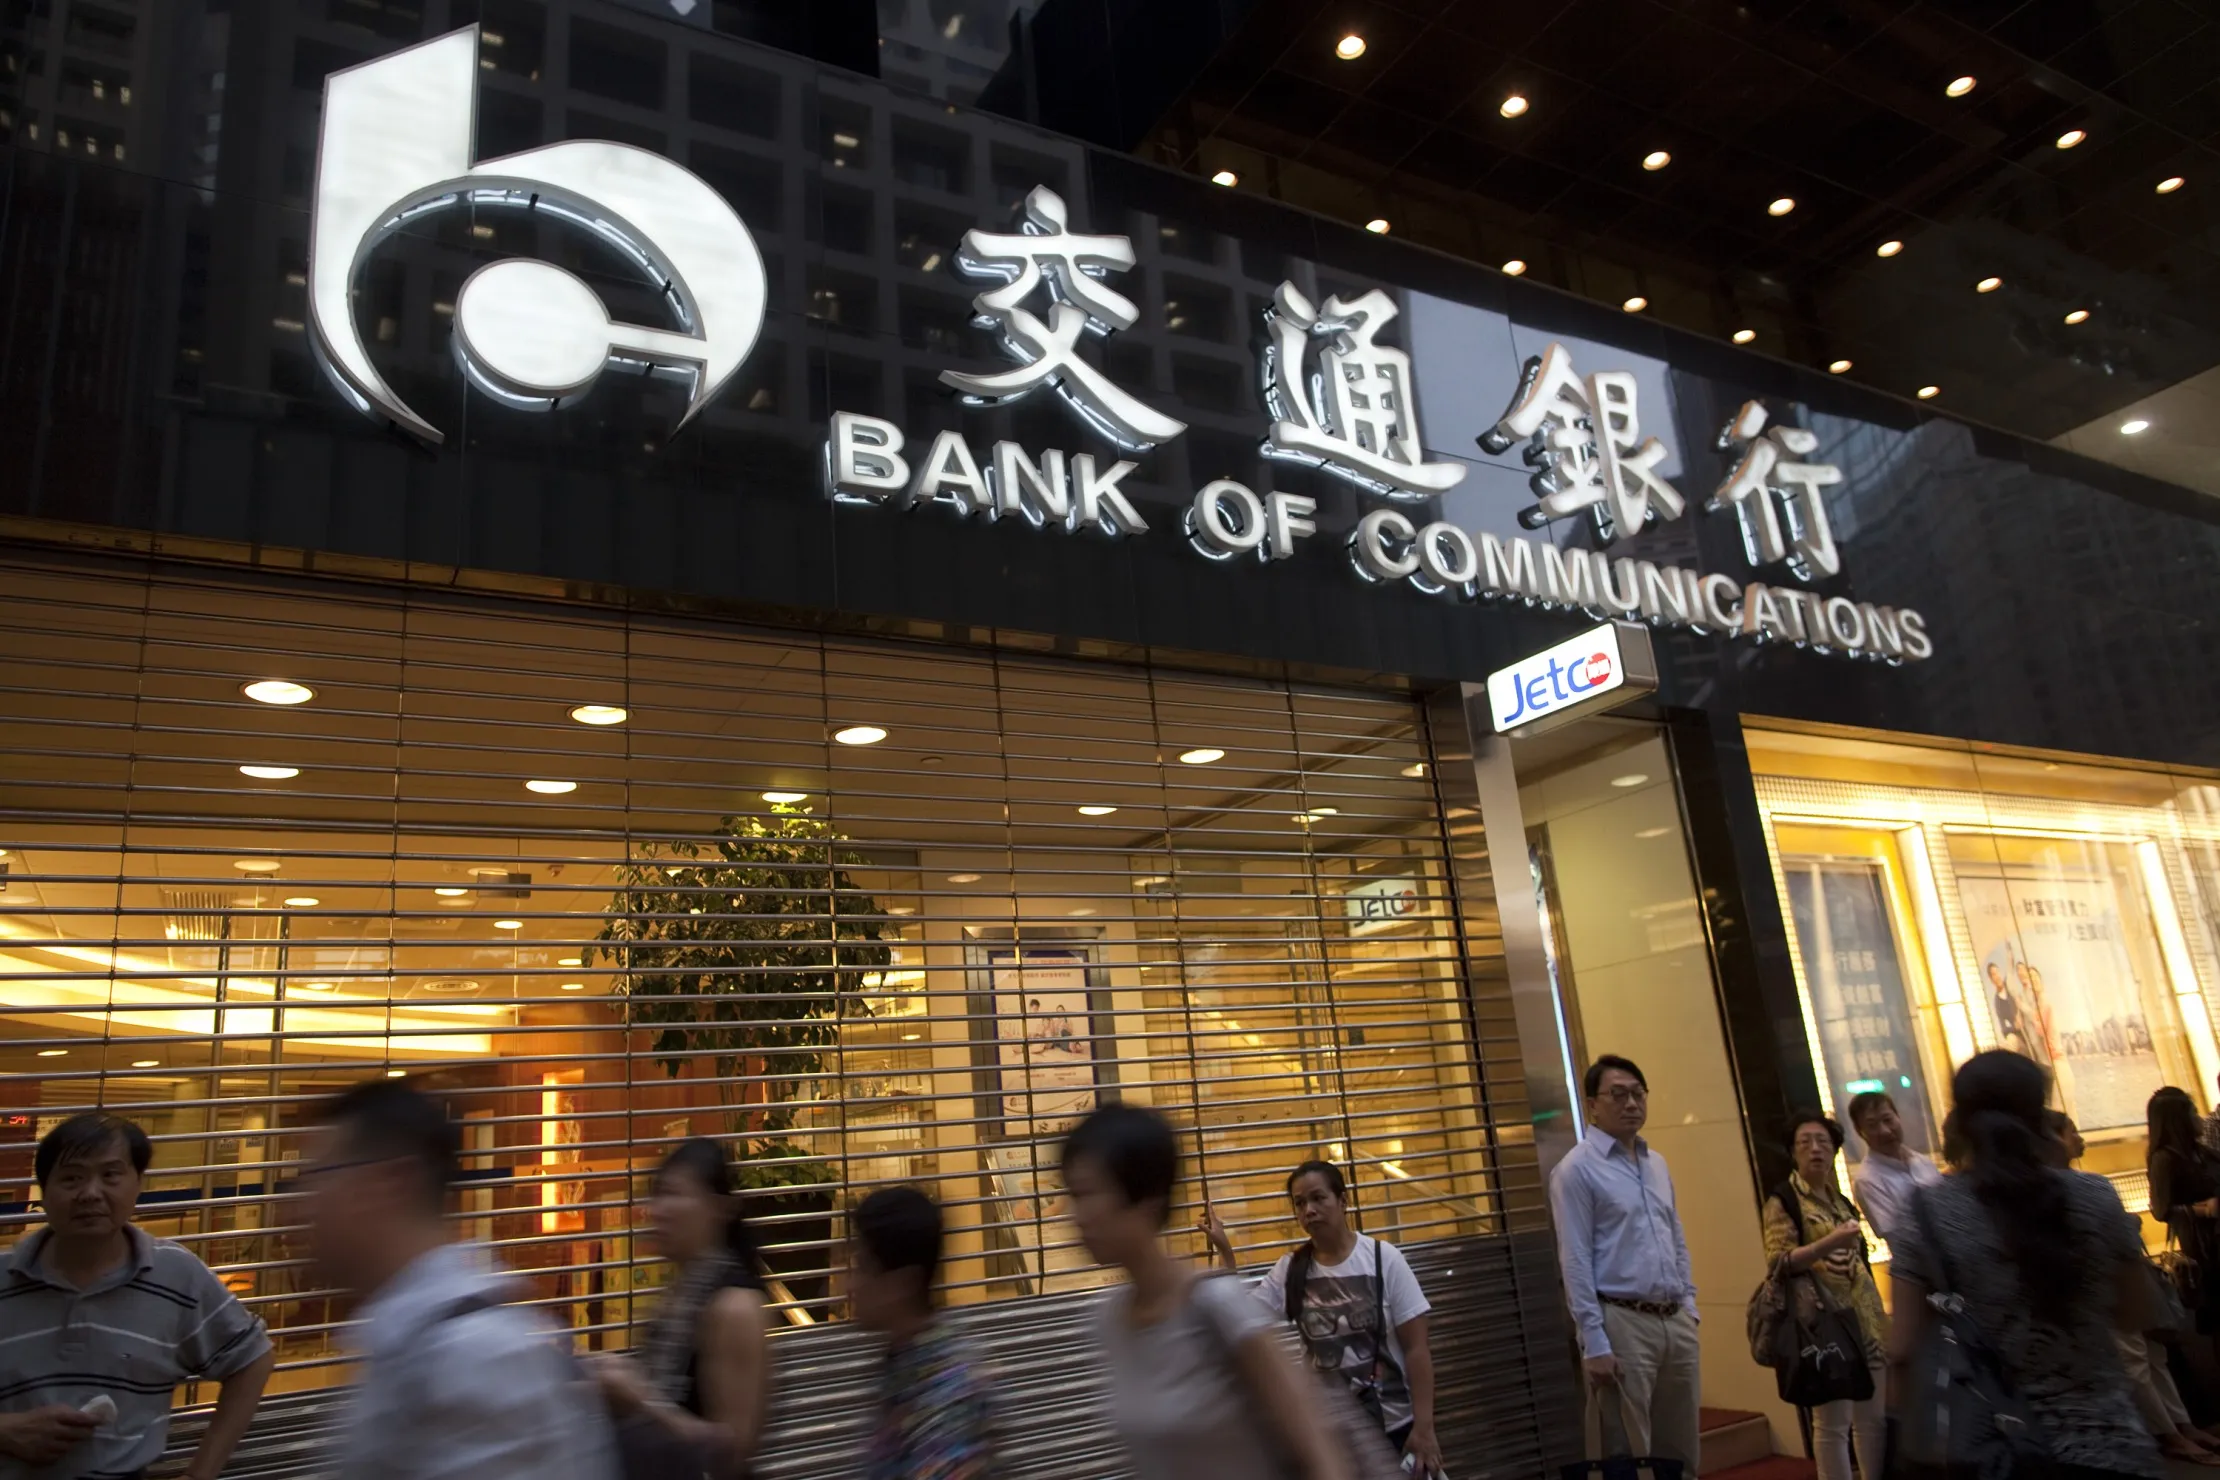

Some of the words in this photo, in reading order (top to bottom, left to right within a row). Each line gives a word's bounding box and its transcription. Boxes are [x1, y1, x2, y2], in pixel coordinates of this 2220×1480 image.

[829, 410, 1150, 535] BANK
[1190, 479, 1316, 560] OF
[1354, 508, 1933, 662] COMMUNICATIONS
[938, 184, 1843, 577] 交通銀行
